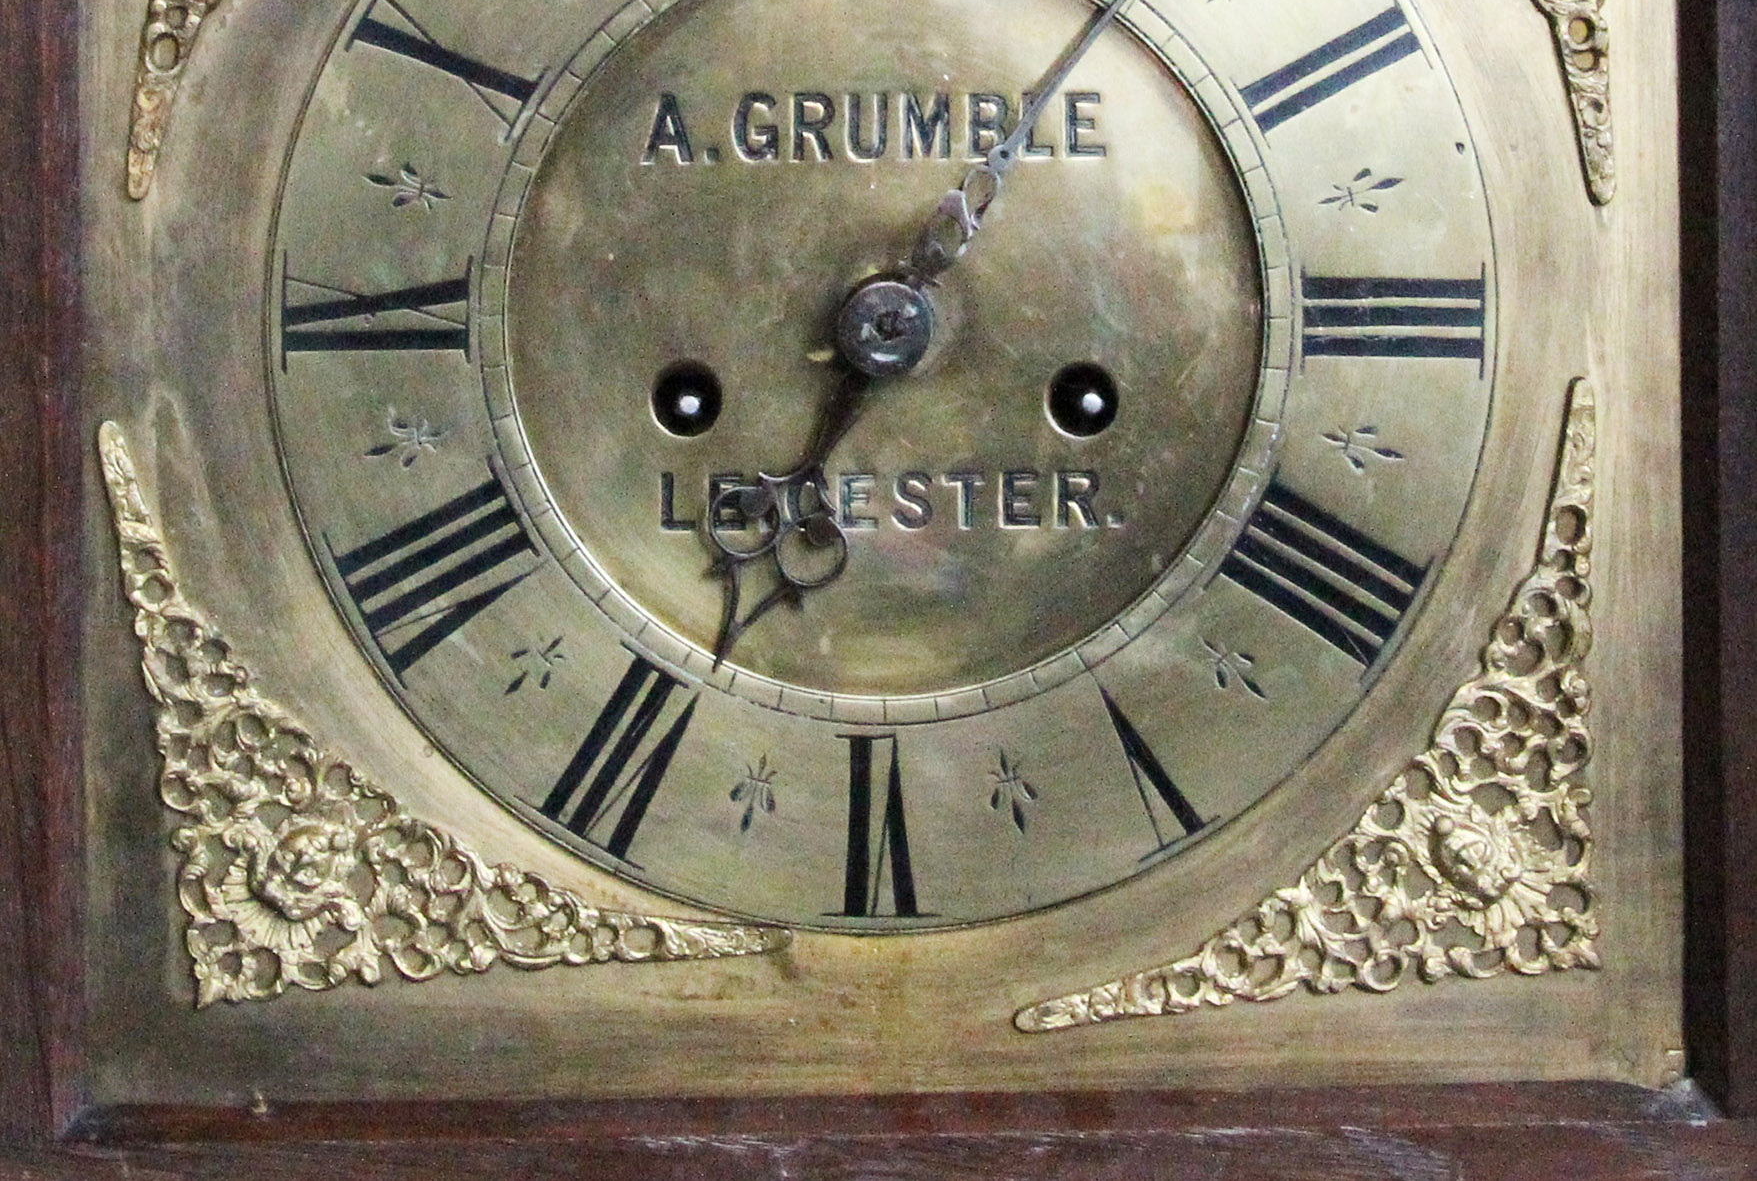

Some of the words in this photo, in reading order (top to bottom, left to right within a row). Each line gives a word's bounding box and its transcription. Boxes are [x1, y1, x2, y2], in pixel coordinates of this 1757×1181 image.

[280, 249, 474, 375] IX
[1300, 261, 1486, 380] III
[321, 455, 548, 689] VIII
[512, 640, 700, 870] VII
[821, 732, 942, 917] VI
[1090, 669, 1221, 863] V
